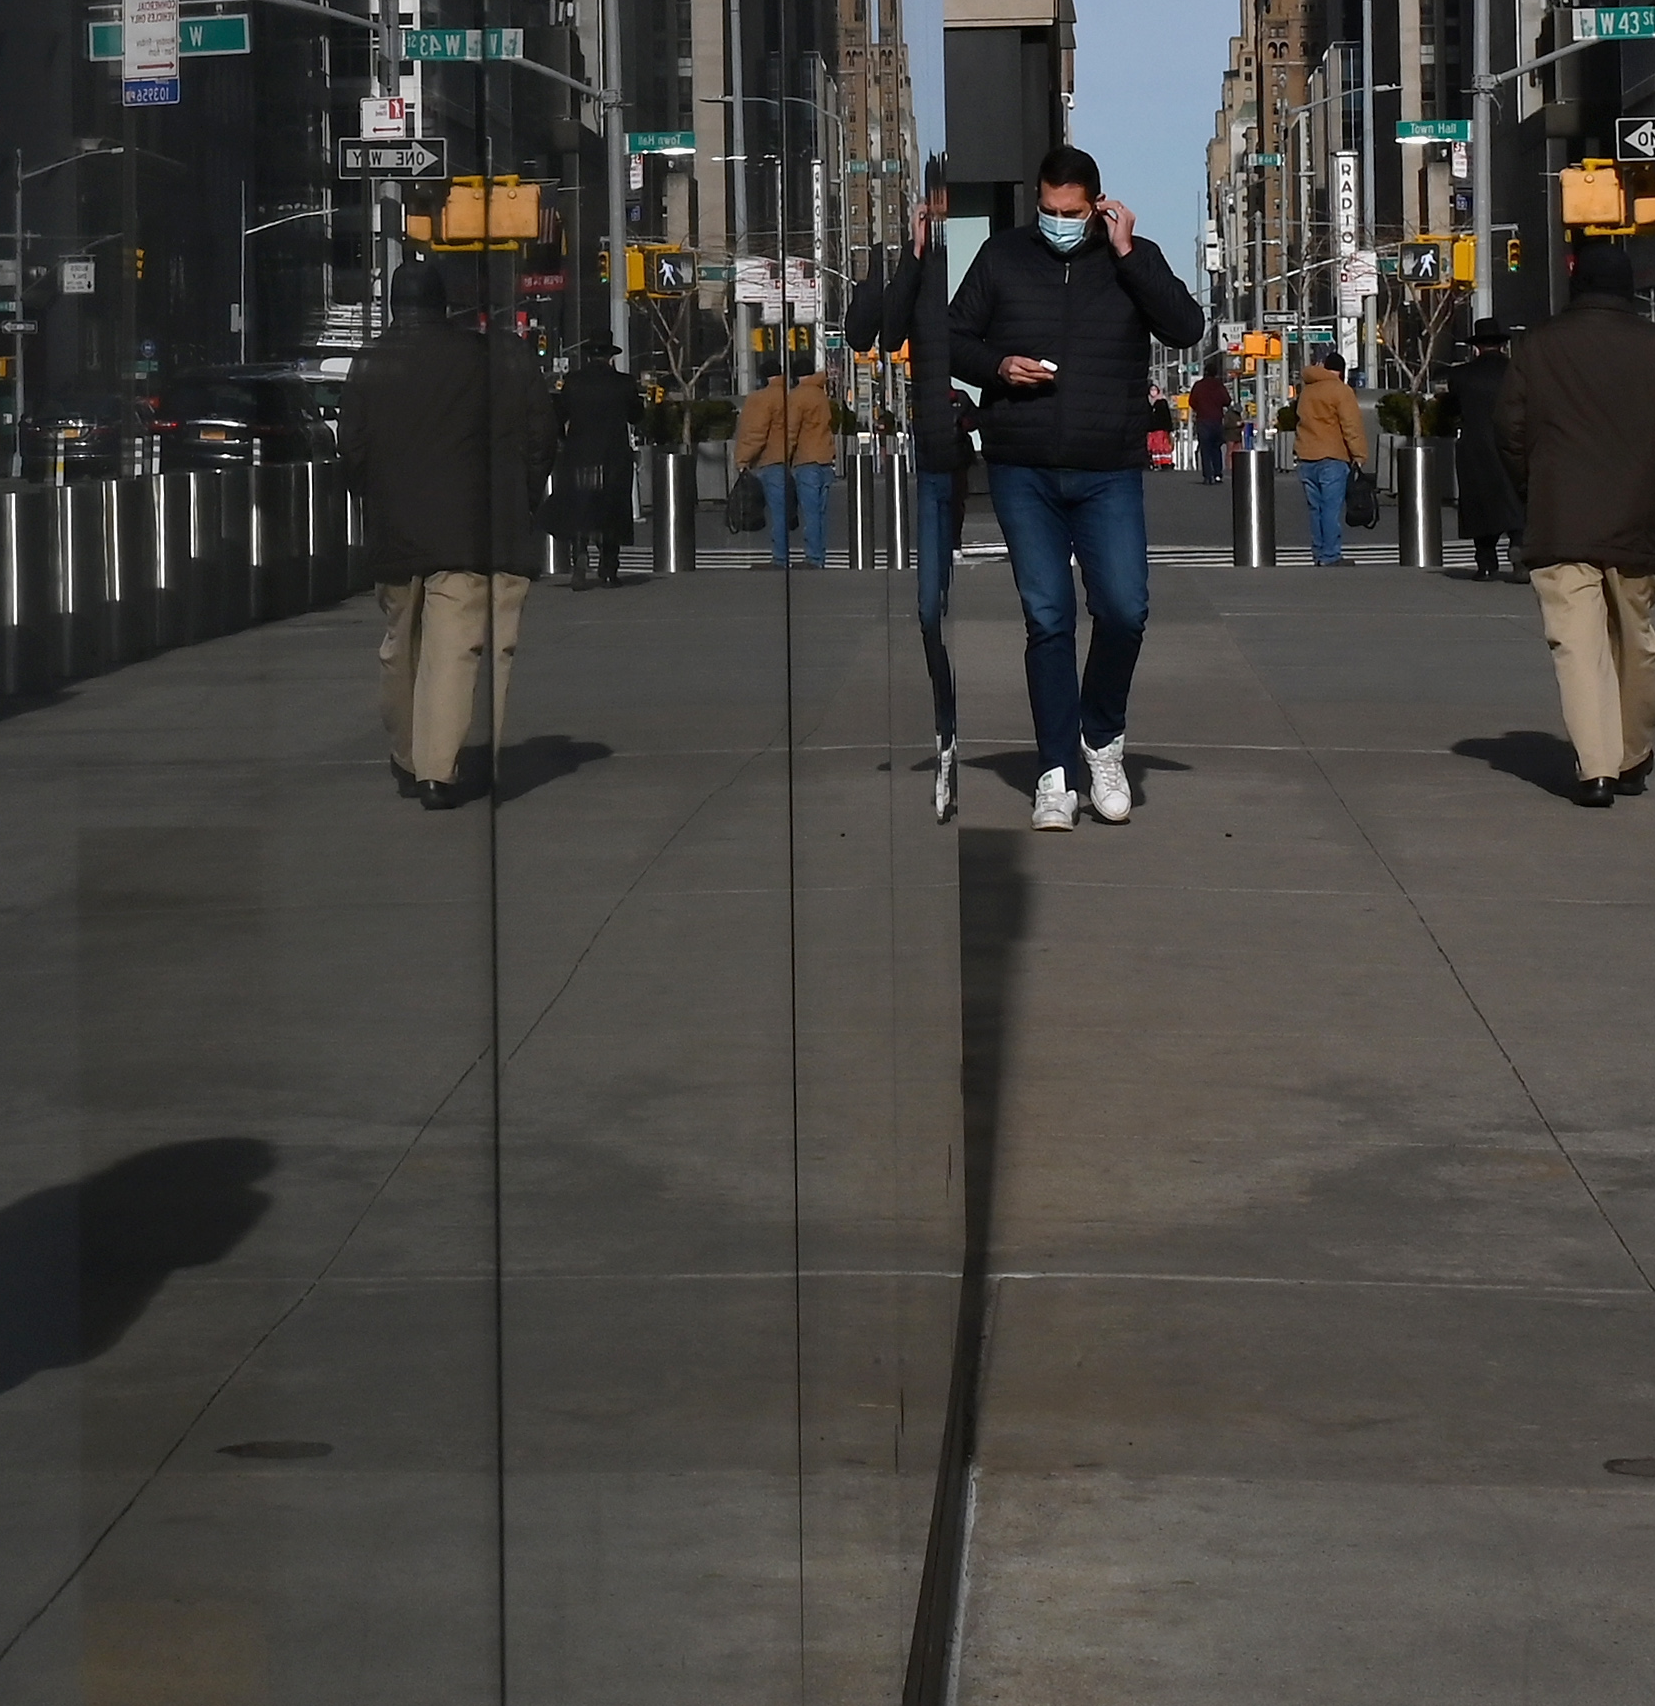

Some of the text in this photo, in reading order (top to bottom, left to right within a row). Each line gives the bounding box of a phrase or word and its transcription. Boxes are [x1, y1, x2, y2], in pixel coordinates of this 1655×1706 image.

[1600, 11, 1654, 35] W 43 St
[1410, 123, 1457, 134] Town Hall
[1341, 163, 1354, 244] RADIO
